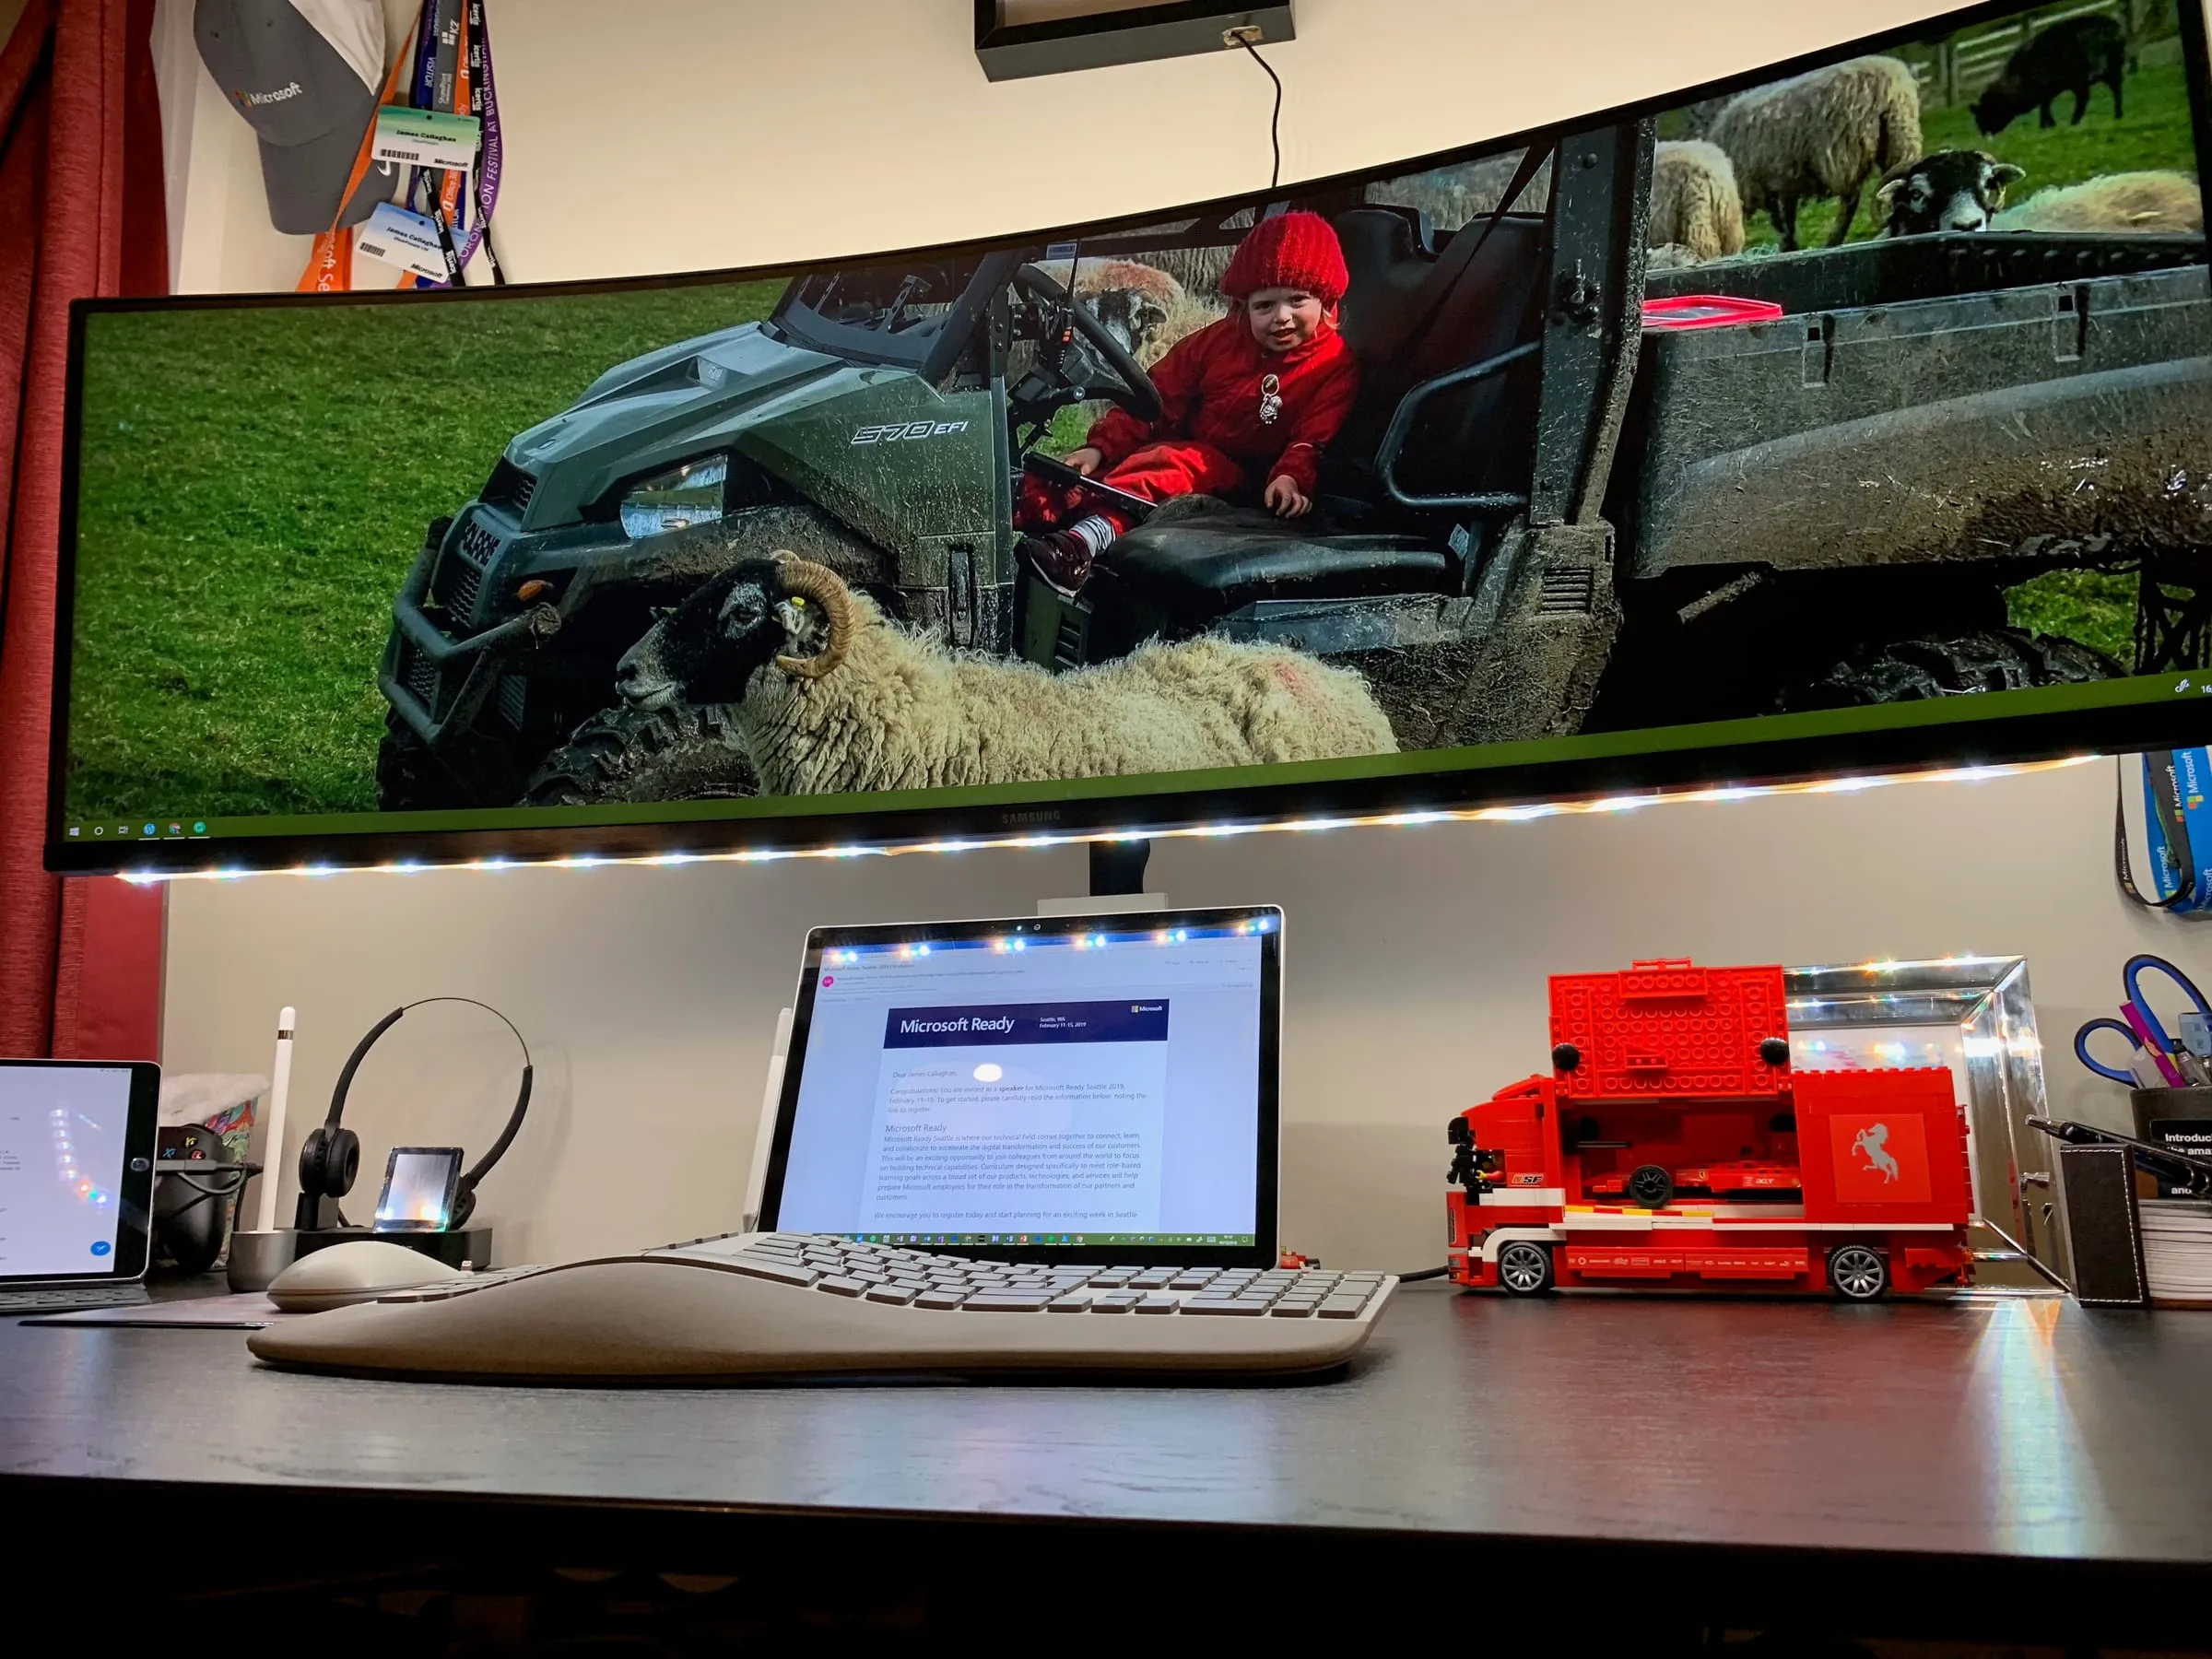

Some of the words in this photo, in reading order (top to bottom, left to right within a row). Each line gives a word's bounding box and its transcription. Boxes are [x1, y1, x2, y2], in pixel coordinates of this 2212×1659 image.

[450, 18, 460, 35] K2
[425, 57, 436, 87] VISITOR
[250, 82, 303, 105] Microsoft
[488, 121, 497, 132] AT
[421, 133, 456, 142] Callaghan
[434, 159, 468, 167] Microsoft
[487, 136, 499, 181] FESTIVAL
[387, 227, 407, 238] James
[410, 264, 442, 278] Microsoft
[851, 421, 935, 444] 570
[934, 421, 969, 434] EFI
[2182, 751, 2198, 794] Microsoft
[1001, 810, 1061, 824] SAMSUNG
[2157, 846, 2173, 888] Microsoft
[900, 1018, 968, 1033] Microsoft
[971, 1017, 1015, 1034] Ready
[999, 1085, 1024, 1093] speaker
[1113, 1092, 1135, 1100] noting
[924, 1124, 947, 1133] Ready
[163, 1147, 176, 1158] X
[1045, 1162, 1078, 1171] specifically
[1523, 1175, 1544, 1183] SF
[966, 1211, 982, 1219] today
[1013, 1211, 1041, 1219] planning
